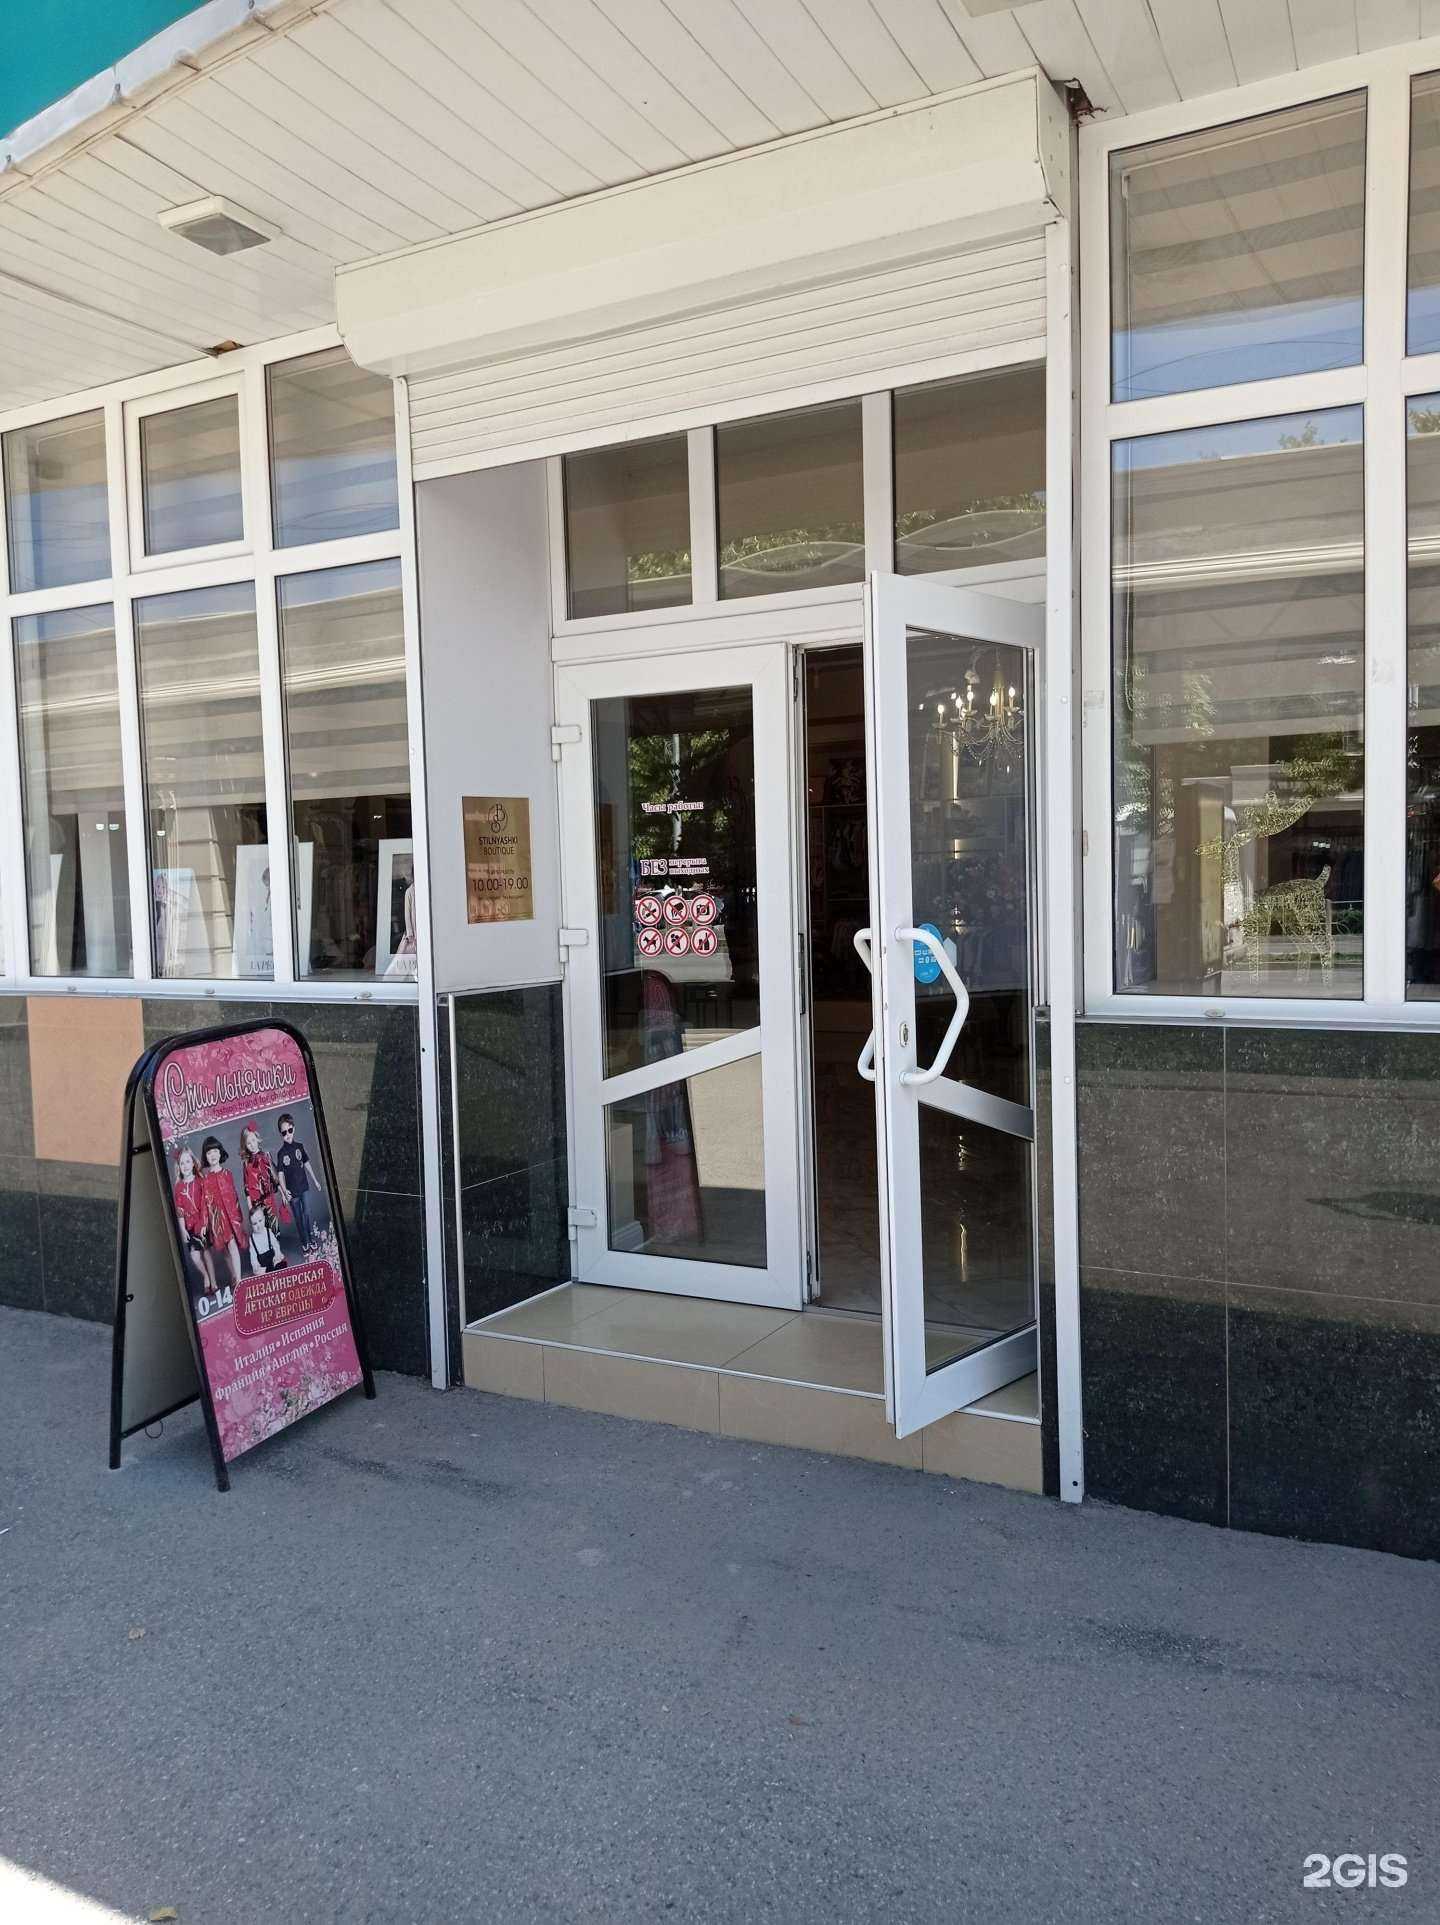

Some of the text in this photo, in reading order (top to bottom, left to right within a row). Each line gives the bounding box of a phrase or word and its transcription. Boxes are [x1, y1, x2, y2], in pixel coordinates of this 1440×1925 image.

[483, 846, 515, 856] BOUTIQUE
[640, 859, 668, 876] БЕЗ
[164, 1062, 297, 1127] Стильняшки
[245, 1267, 325, 1300] ДИЗАЙНЕРСКАЯ
[197, 1286, 233, 1316] 0-14
[244, 1281, 327, 1317] ДЕТСКАЯ ОДЕЖДА
[275, 1297, 315, 1320] ЕВРОПЫ
[234, 1315, 326, 1371] Италия Испания
[314, 1321, 348, 1349] Россия
